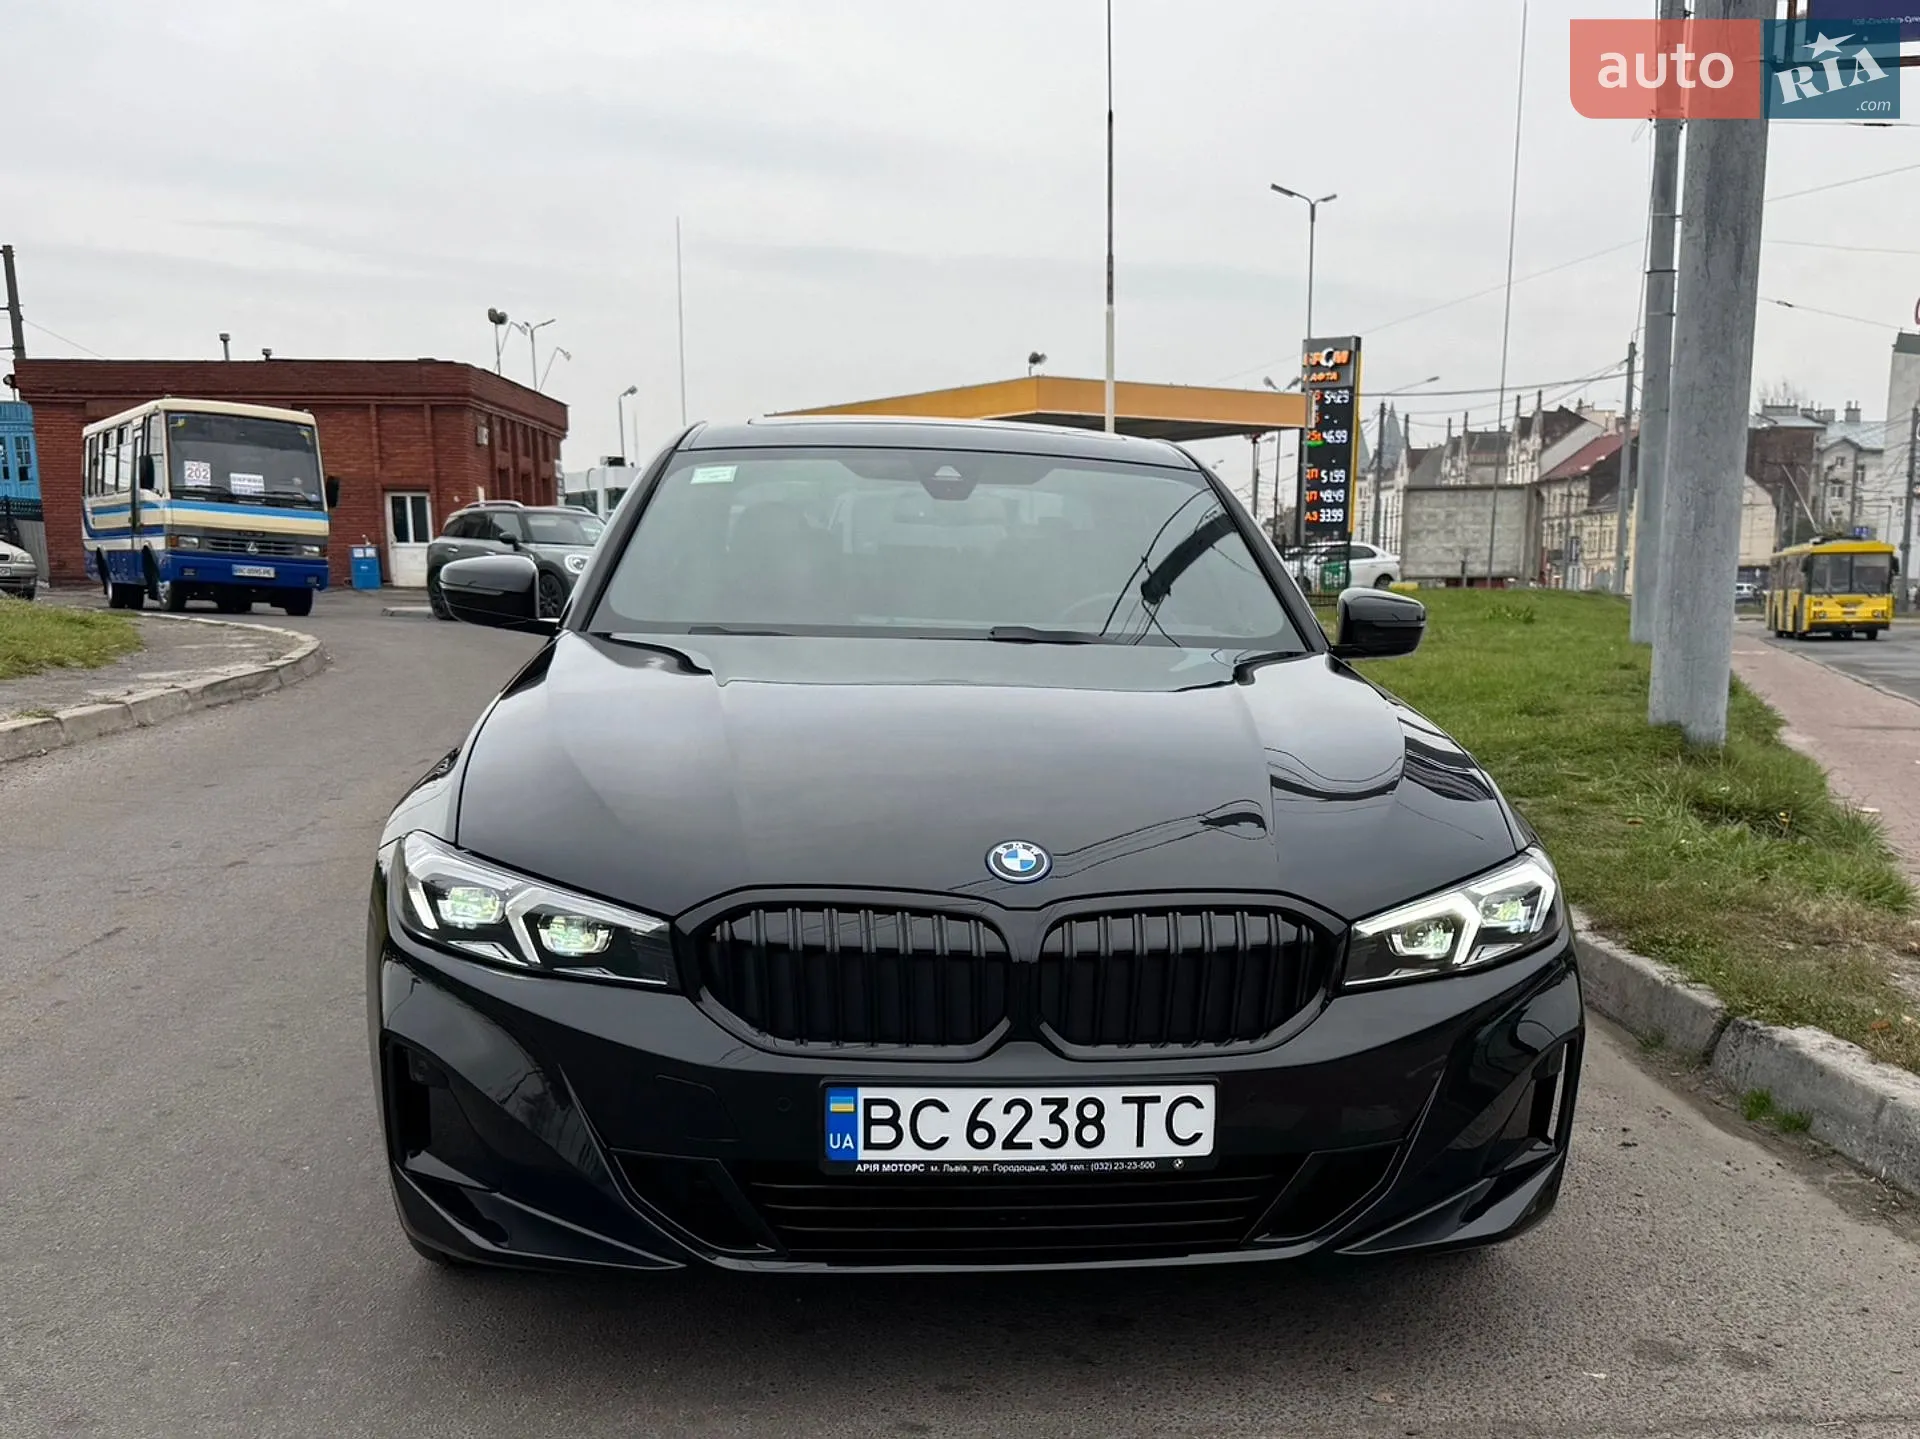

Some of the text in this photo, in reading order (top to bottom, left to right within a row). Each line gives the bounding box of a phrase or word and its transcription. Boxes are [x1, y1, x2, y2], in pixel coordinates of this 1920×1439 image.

[187, 467, 209, 479] 202
[863, 1095, 1205, 1151] BC 6238 TC
[829, 1132, 855, 1149] UA
[855, 1163, 880, 1173] АРІЯ
[881, 1163, 926, 1173] МОТОРС
[1090, 1161, 1113, 1172] (032)
[1113, 1161, 1156, 1171] 23-23-500
